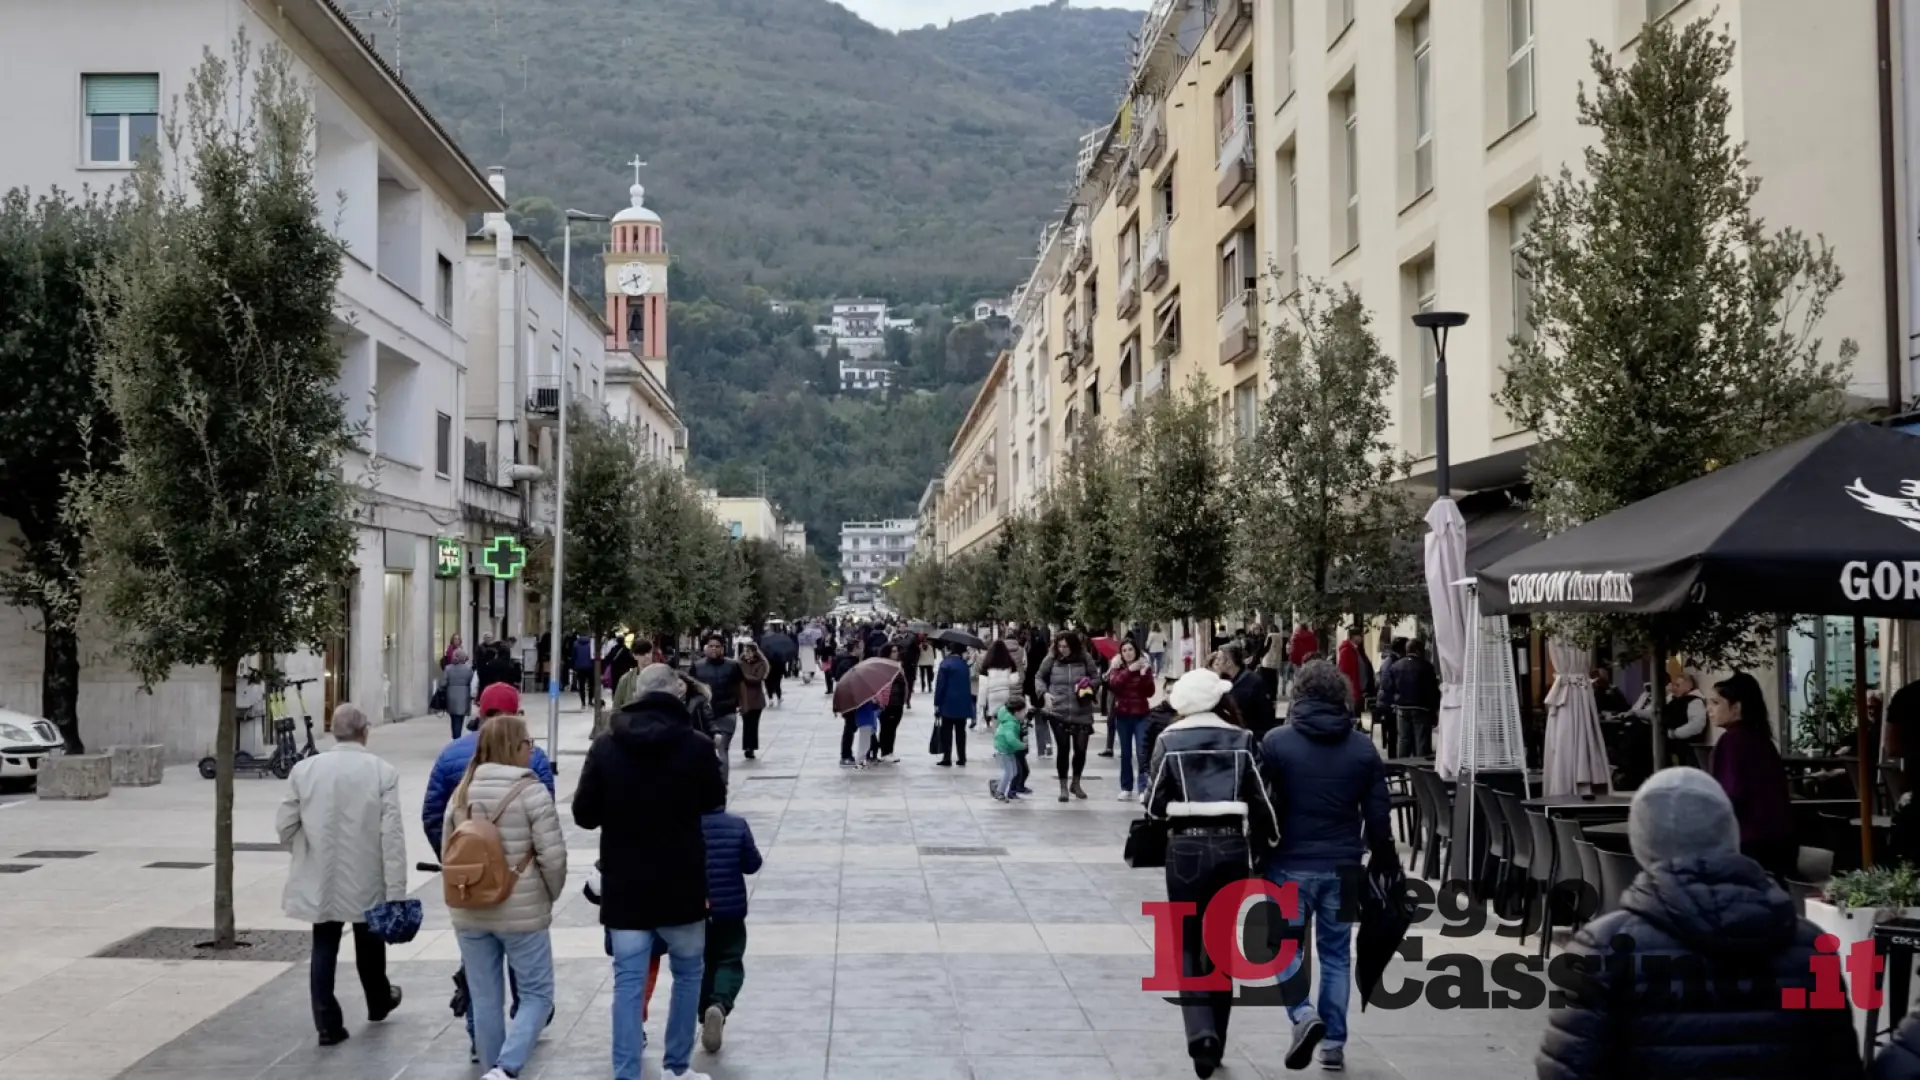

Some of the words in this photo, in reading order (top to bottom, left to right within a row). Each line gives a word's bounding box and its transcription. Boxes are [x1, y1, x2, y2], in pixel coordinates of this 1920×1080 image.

[1508, 571, 1571, 604] GORDON
[1567, 570, 1602, 601] FINEST
[1601, 570, 1633, 603] BEERS
[1839, 560, 1920, 602] GOR
